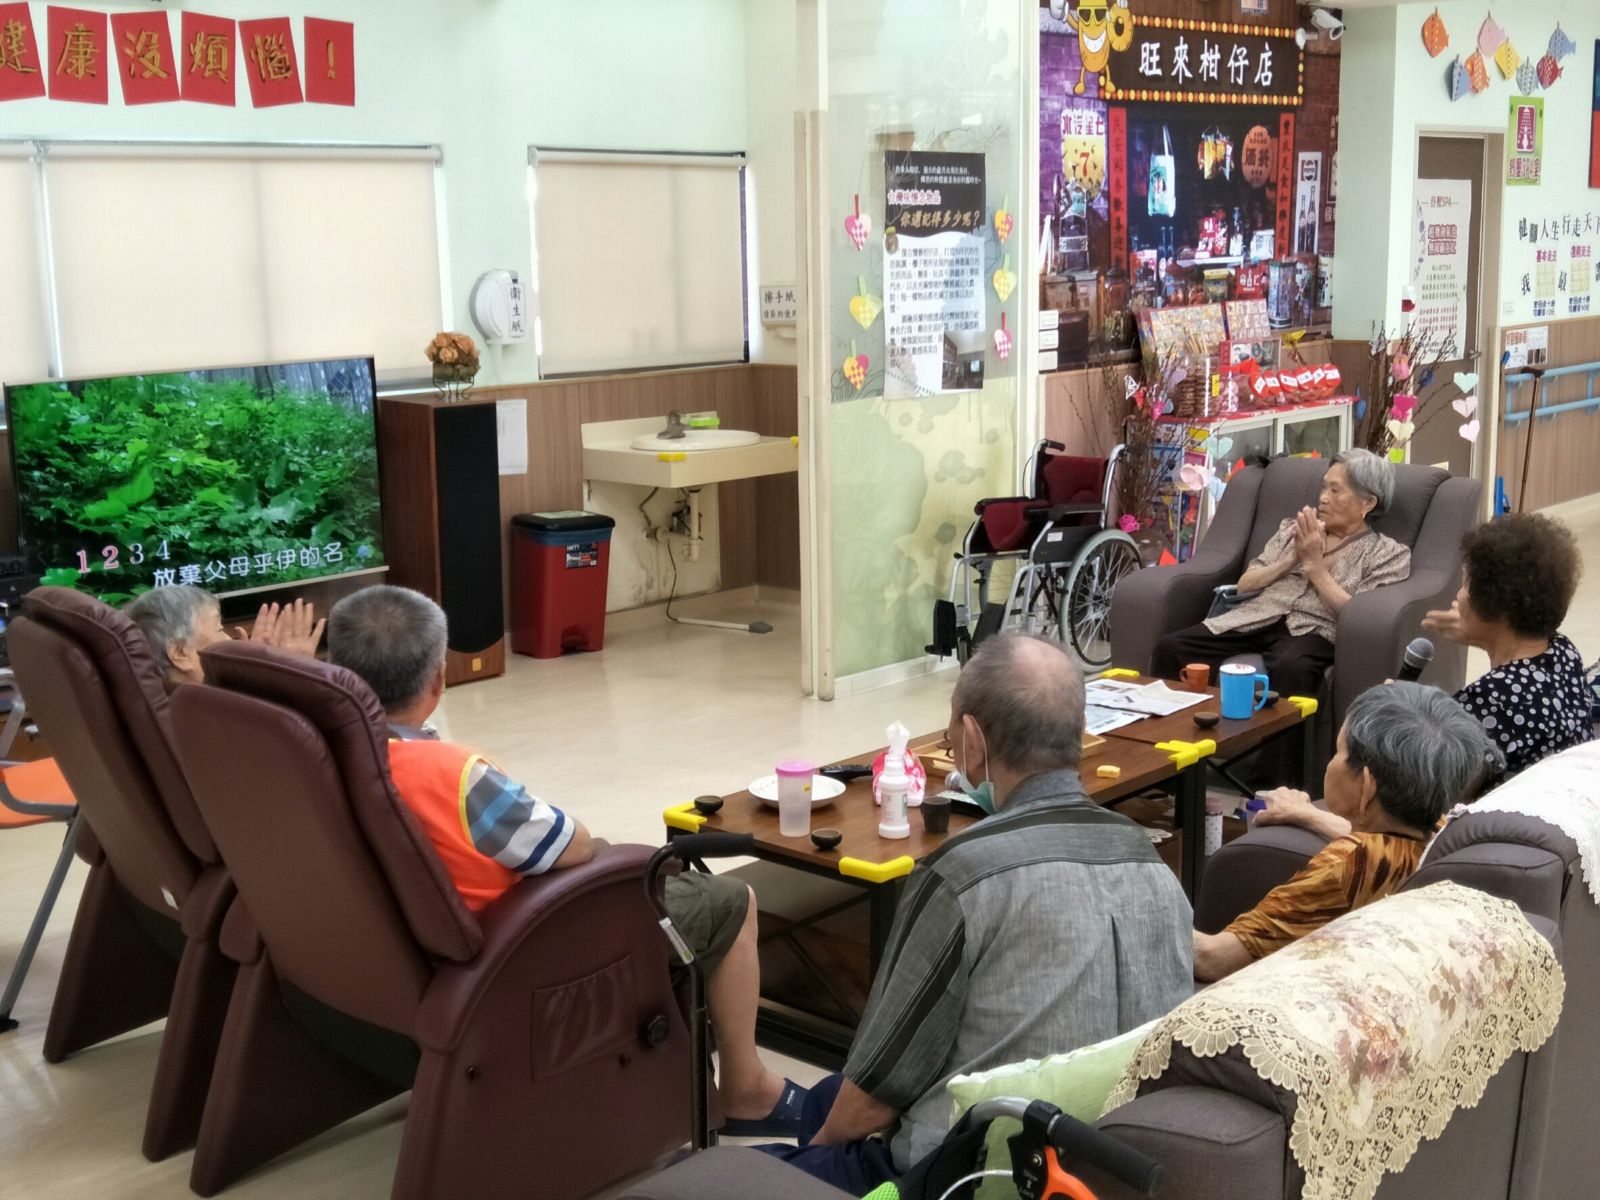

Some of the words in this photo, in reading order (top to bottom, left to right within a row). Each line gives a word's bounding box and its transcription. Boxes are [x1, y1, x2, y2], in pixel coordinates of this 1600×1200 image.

[1139, 36, 1273, 87] 旺來柑仔店
[1080, 152, 1090, 177] 7
[76, 550, 92, 574] 1
[102, 545, 120, 568] 2
[130, 543, 145, 565] 3
[155, 540, 171, 561] 4
[153, 541, 344, 590] 放棄父母乎伊的名
